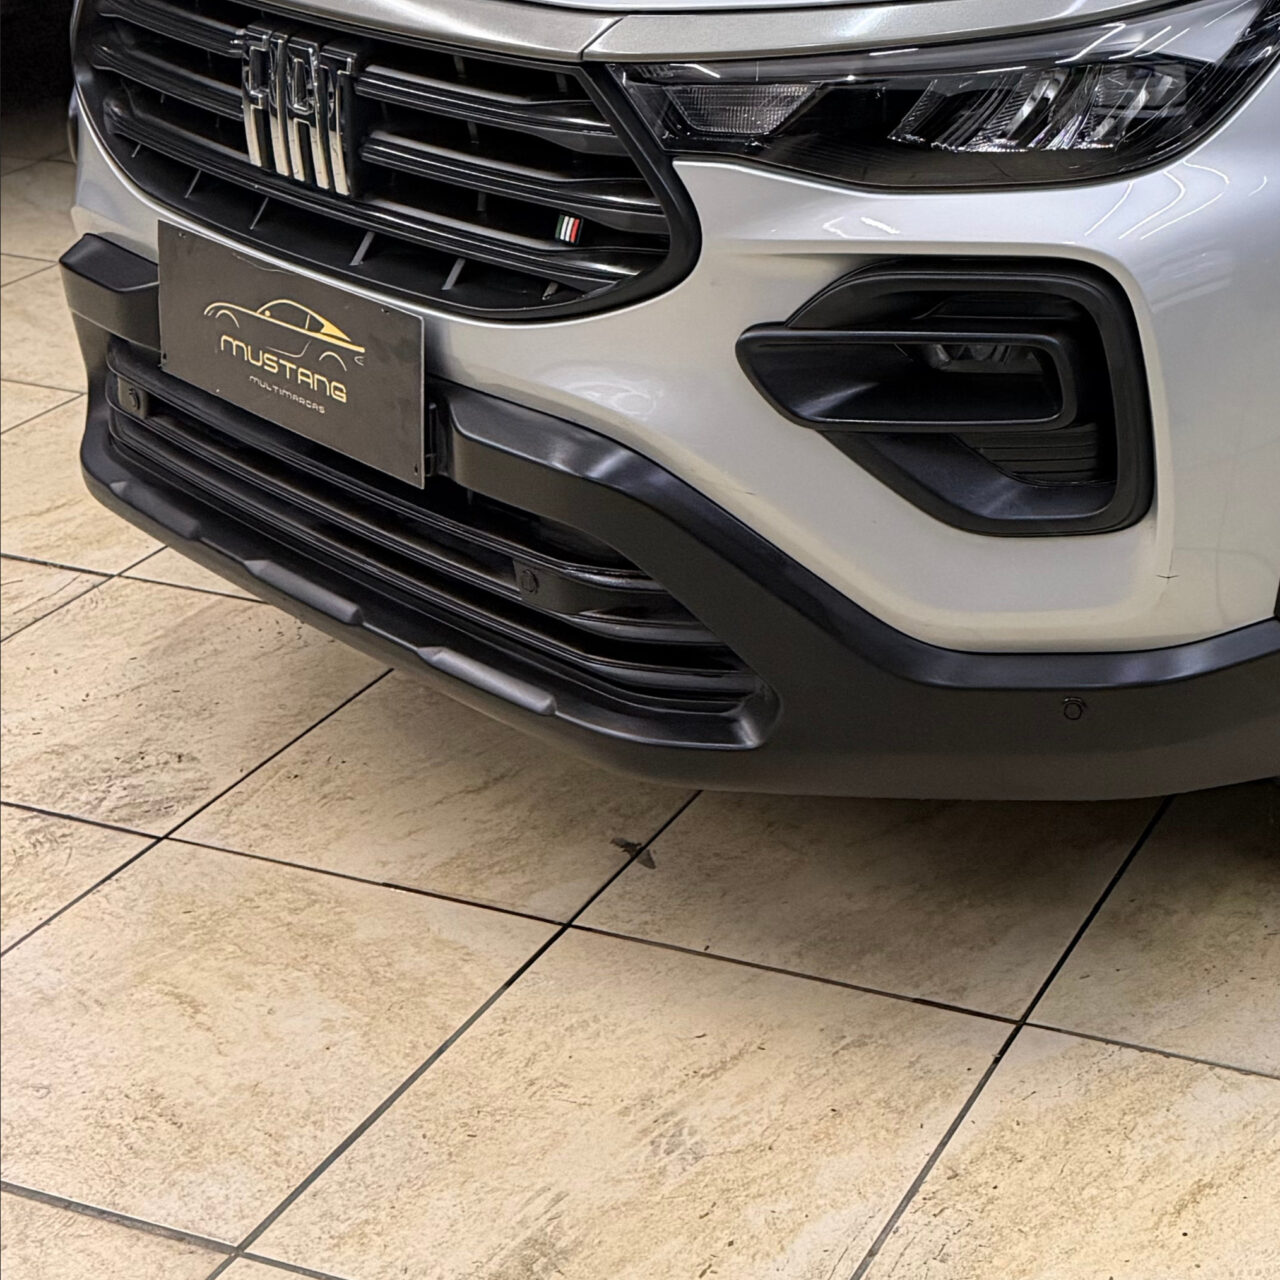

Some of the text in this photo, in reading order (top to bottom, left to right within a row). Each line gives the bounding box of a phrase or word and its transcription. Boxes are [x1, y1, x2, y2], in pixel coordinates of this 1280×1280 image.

[243, 26, 356, 196] FIAT
[220, 334, 347, 404] MUSTANG
[249, 375, 326, 414] MULTIMARCAS
